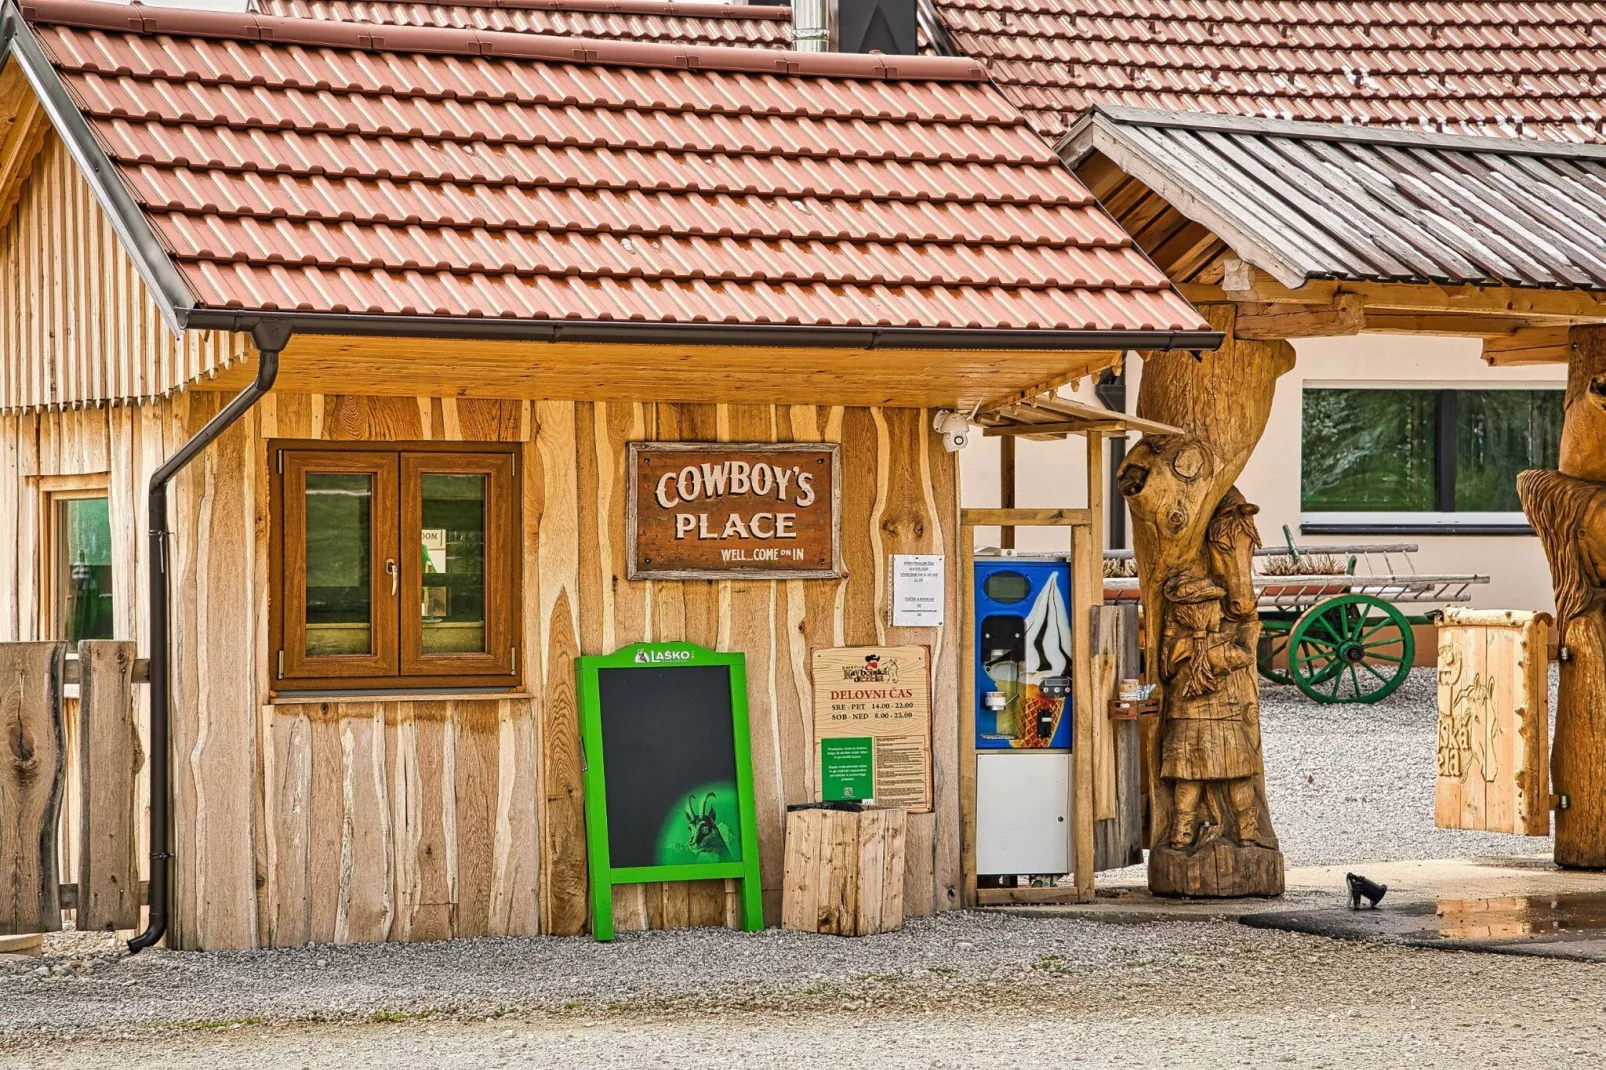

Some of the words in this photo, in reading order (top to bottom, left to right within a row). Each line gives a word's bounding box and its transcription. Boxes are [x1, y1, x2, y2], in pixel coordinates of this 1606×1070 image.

[655, 461, 816, 509] COWBOY'S
[675, 512, 798, 540] PLACE
[792, 548, 804, 560] IN
[651, 649, 690, 663] LAŠKO
[831, 689, 886, 700] DELOVNI
[889, 687, 913, 699] ČAS
[832, 703, 846, 711] SRE
[832, 713, 848, 721] SOB
[894, 711, 913, 719] 22.00
